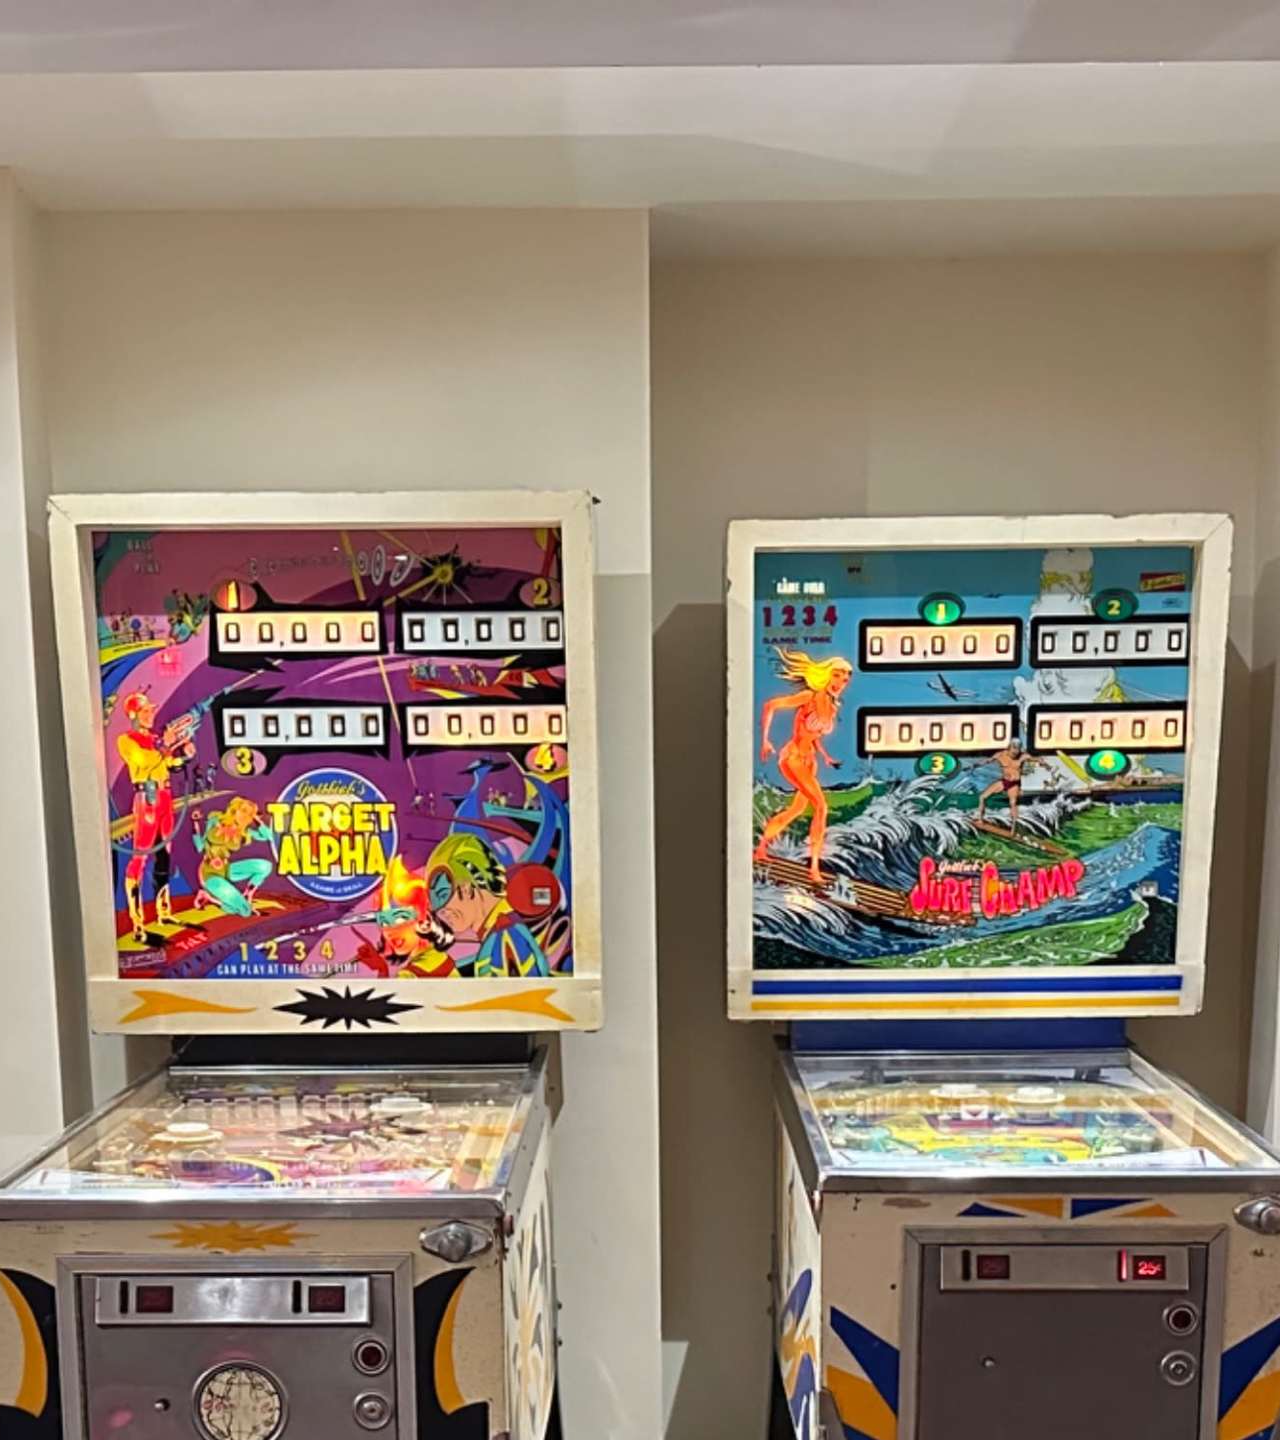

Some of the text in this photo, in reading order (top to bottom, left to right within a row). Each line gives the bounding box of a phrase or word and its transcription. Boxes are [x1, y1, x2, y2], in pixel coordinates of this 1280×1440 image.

[532, 577, 551, 605] 2
[763, 605, 838, 627] 1 2 3 4
[1107, 600, 1121, 615] 2
[234, 747, 254, 775] 3
[534, 742, 555, 771] 4
[931, 755, 945, 774] 3
[1099, 753, 1116, 770] 4
[268, 802, 396, 833] TARGET
[277, 833, 388, 876] ALPHA
[911, 857, 1085, 919] SURF CHAMP
[239, 939, 334, 962] 1 2 3 4
[217, 963, 238, 976] CAN
[240, 963, 266, 976] PLAY
[268, 963, 279, 975] AT
